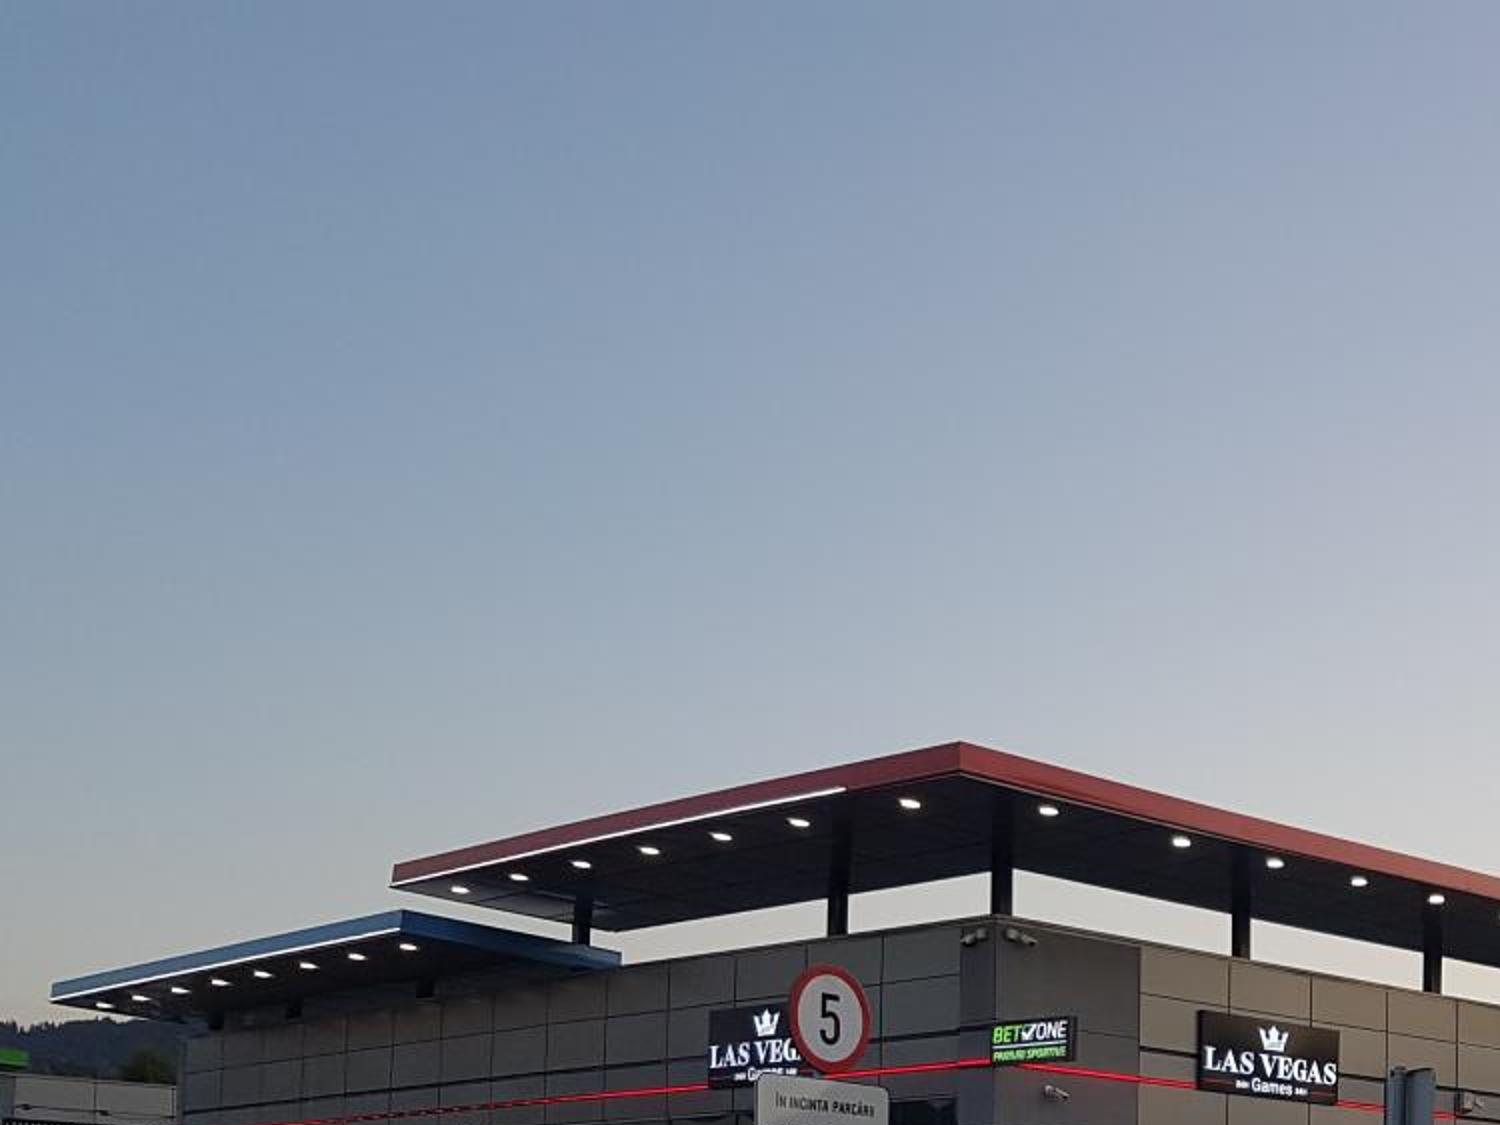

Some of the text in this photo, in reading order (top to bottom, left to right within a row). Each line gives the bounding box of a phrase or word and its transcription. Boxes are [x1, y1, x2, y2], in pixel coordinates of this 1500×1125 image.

[819, 991, 841, 1046] 5
[709, 1037, 801, 1069] LAS VEG
[1203, 1045, 1337, 1085] LAS VEGAS
[1251, 1077, 1293, 1096] Games
